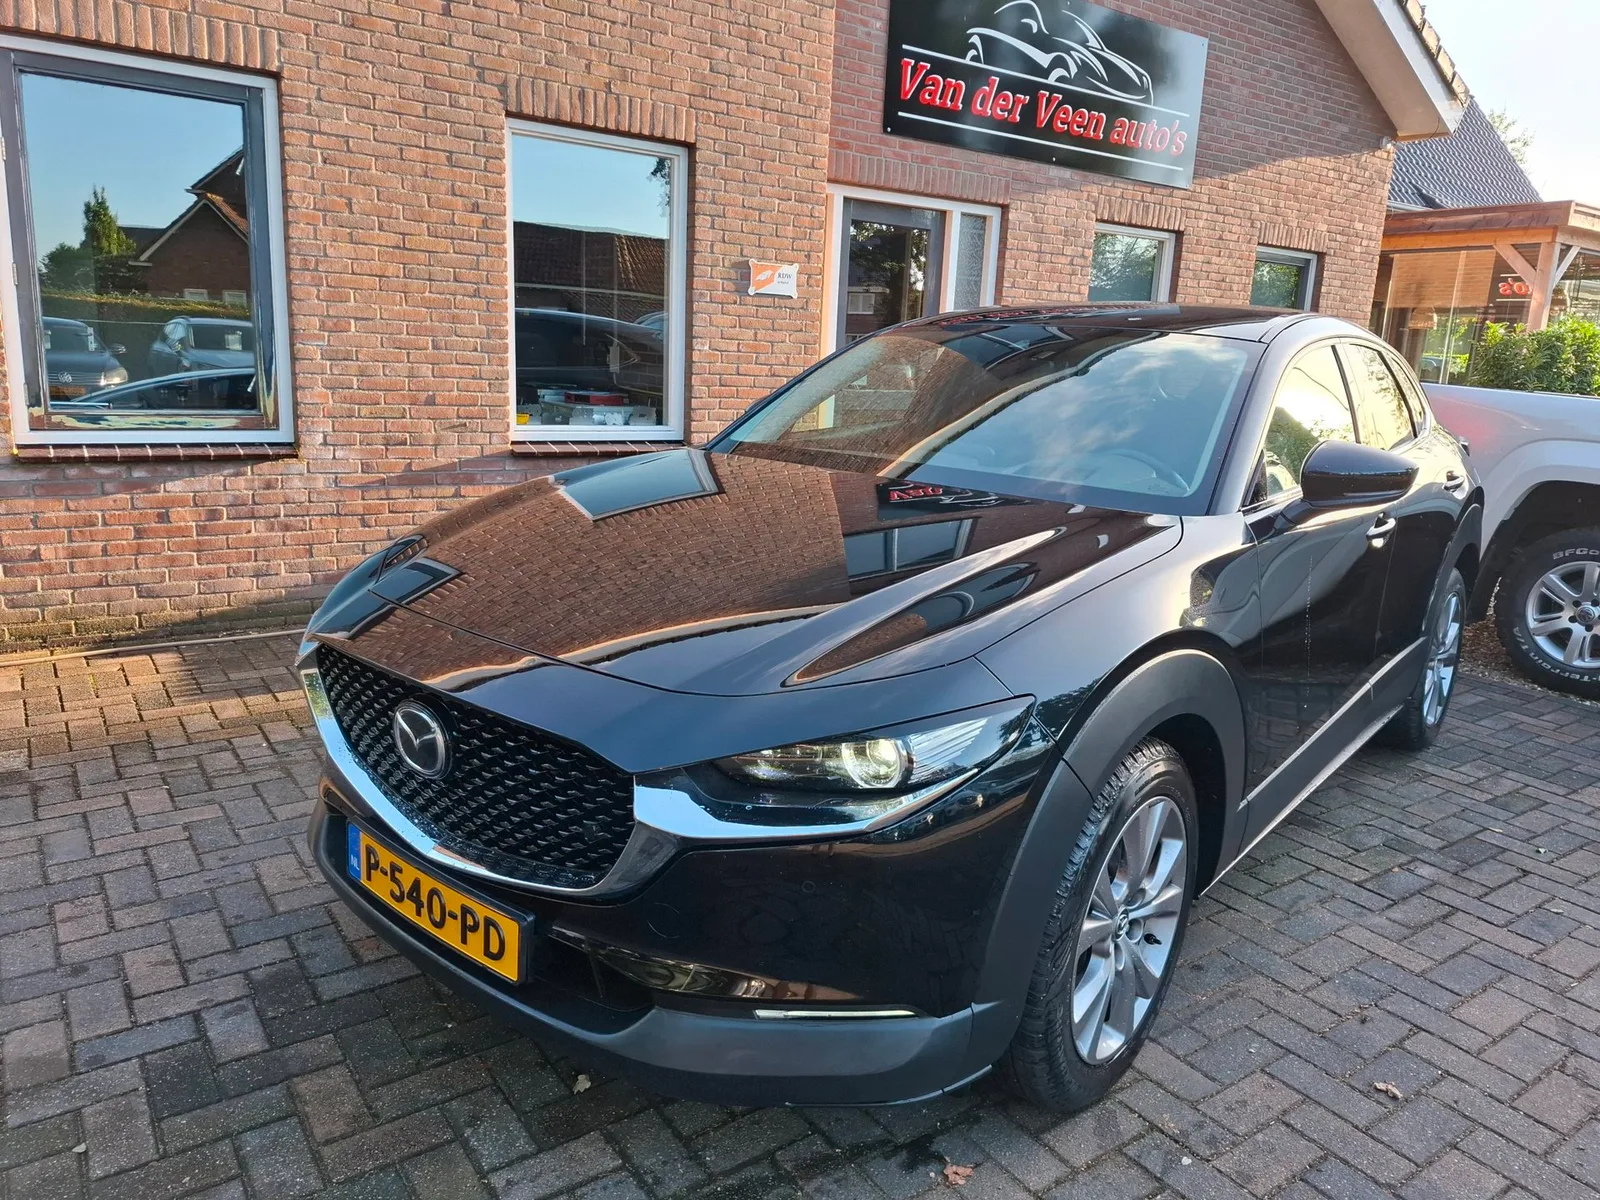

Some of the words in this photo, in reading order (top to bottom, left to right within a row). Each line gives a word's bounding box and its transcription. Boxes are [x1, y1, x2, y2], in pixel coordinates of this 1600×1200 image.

[899, 57, 966, 112] Van
[971, 76, 1030, 125] der
[1035, 90, 1107, 141] Veen
[1109, 117, 1188, 156] auto's
[350, 854, 360, 871] NL
[365, 843, 506, 961] P-540-PD
